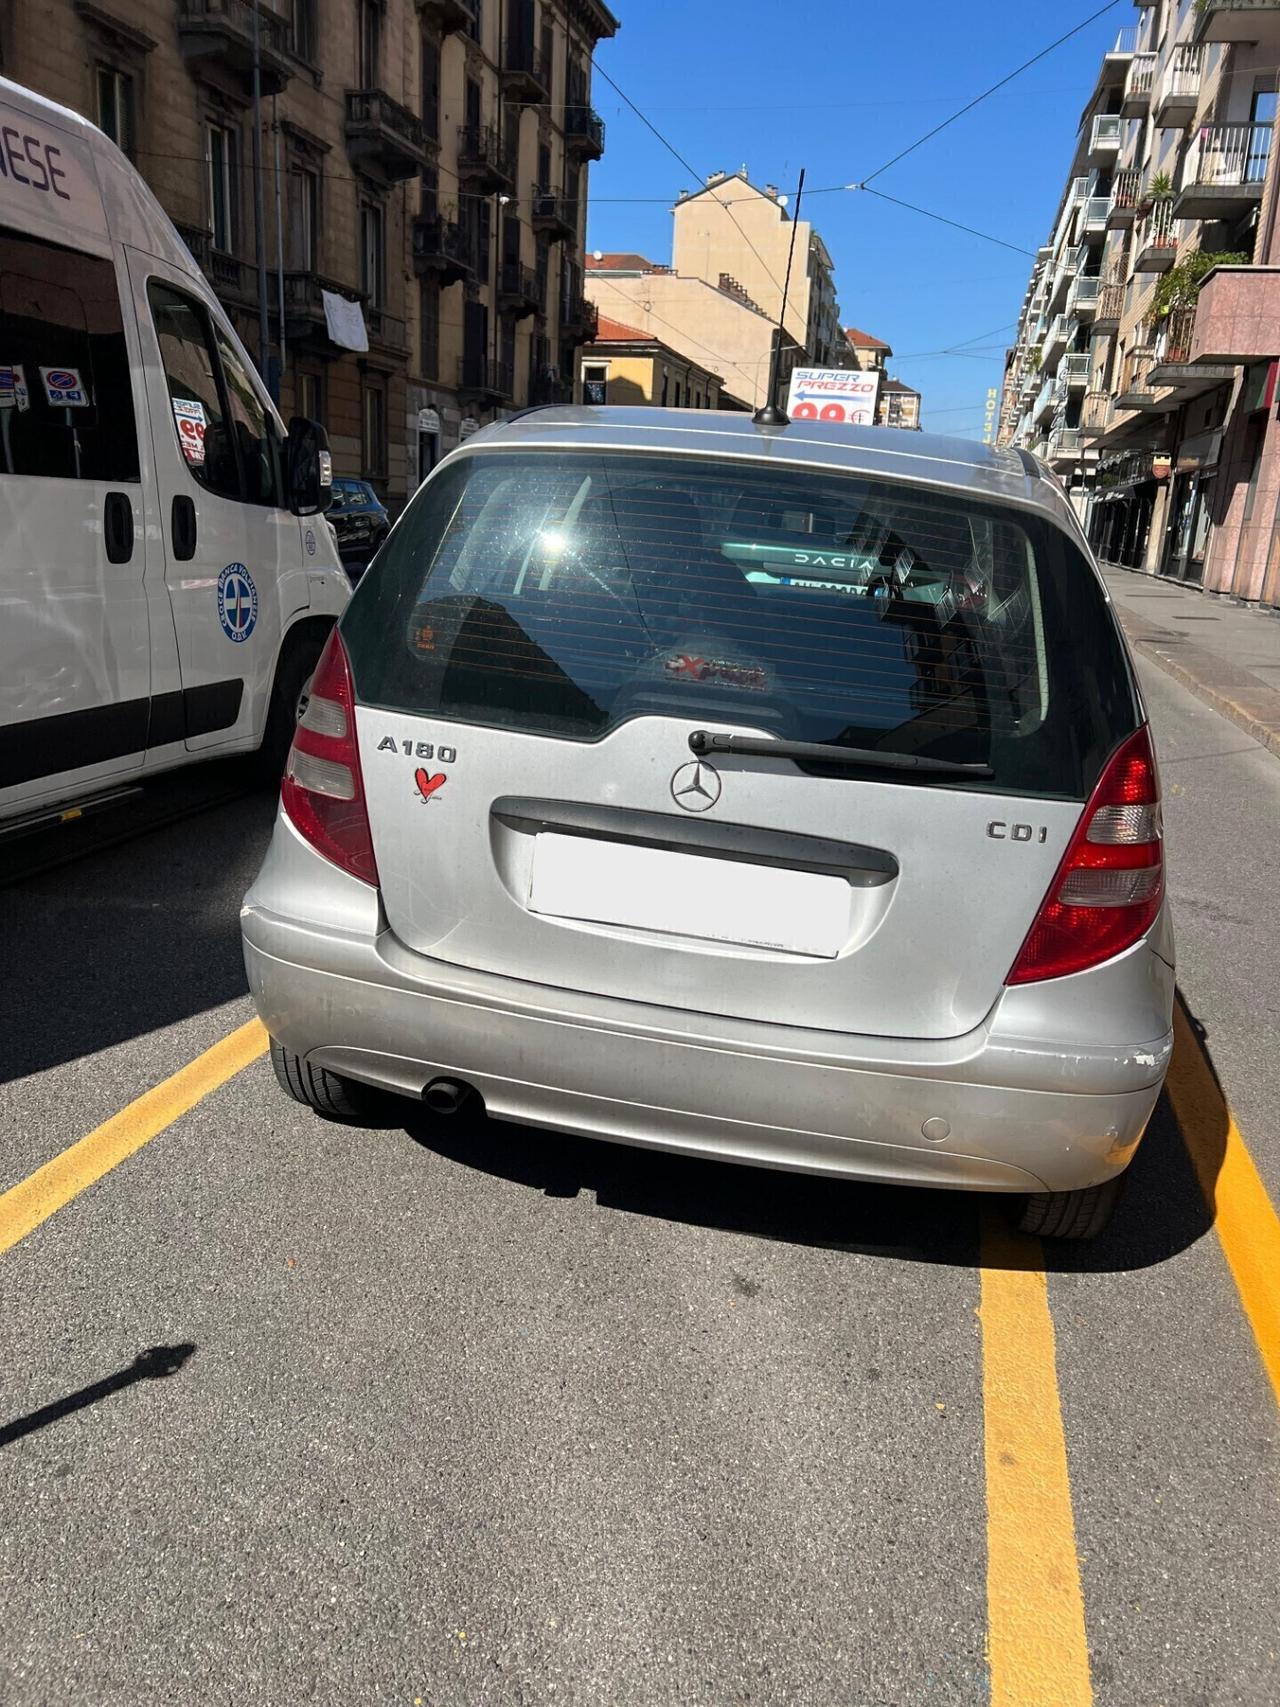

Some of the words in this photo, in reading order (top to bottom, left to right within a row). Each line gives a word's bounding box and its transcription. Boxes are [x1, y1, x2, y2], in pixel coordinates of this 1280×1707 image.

[795, 371, 861, 383] SUPER
[797, 380, 875, 394] PREZZO
[982, 387, 998, 445] HOTEL
[794, 553, 874, 570] DACIA
[376, 735, 457, 764] A180
[986, 820, 1047, 844] CDI
